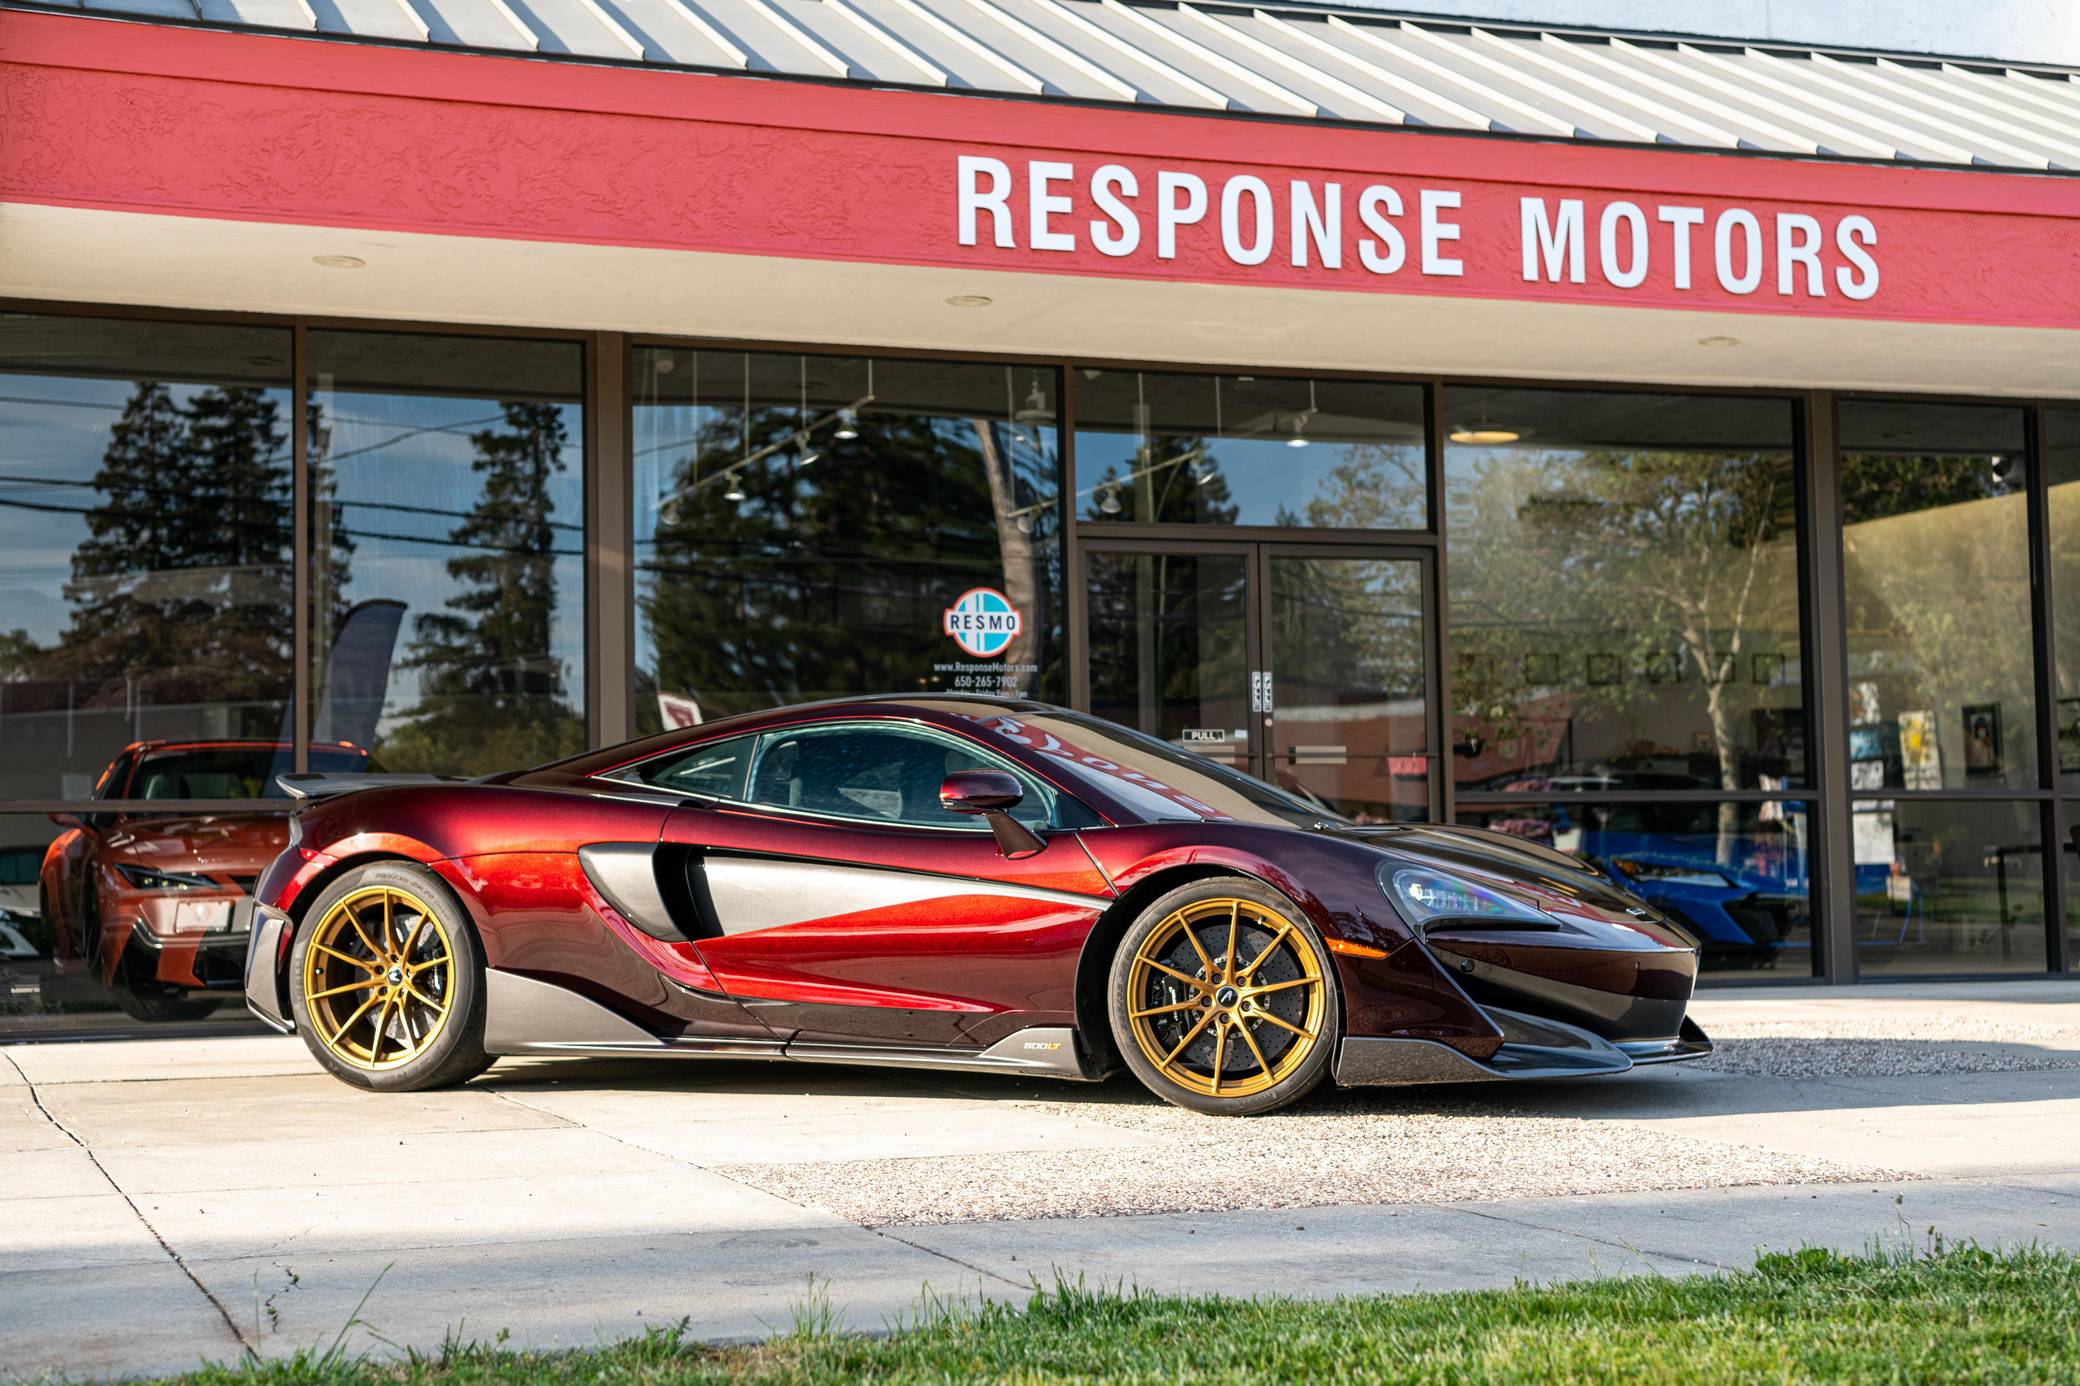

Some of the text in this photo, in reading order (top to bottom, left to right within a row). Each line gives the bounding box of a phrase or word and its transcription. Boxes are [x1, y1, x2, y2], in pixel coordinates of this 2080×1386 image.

[957, 154, 1881, 301] RESPONSE MOTORS
[950, 614, 1016, 631] RESMO
[933, 661, 1038, 674] www.ResponseMotors.com
[954, 676, 1018, 687] 650-265-7902
[1191, 731, 1216, 740] PULL
[1023, 1042, 1061, 1050] 600LT
